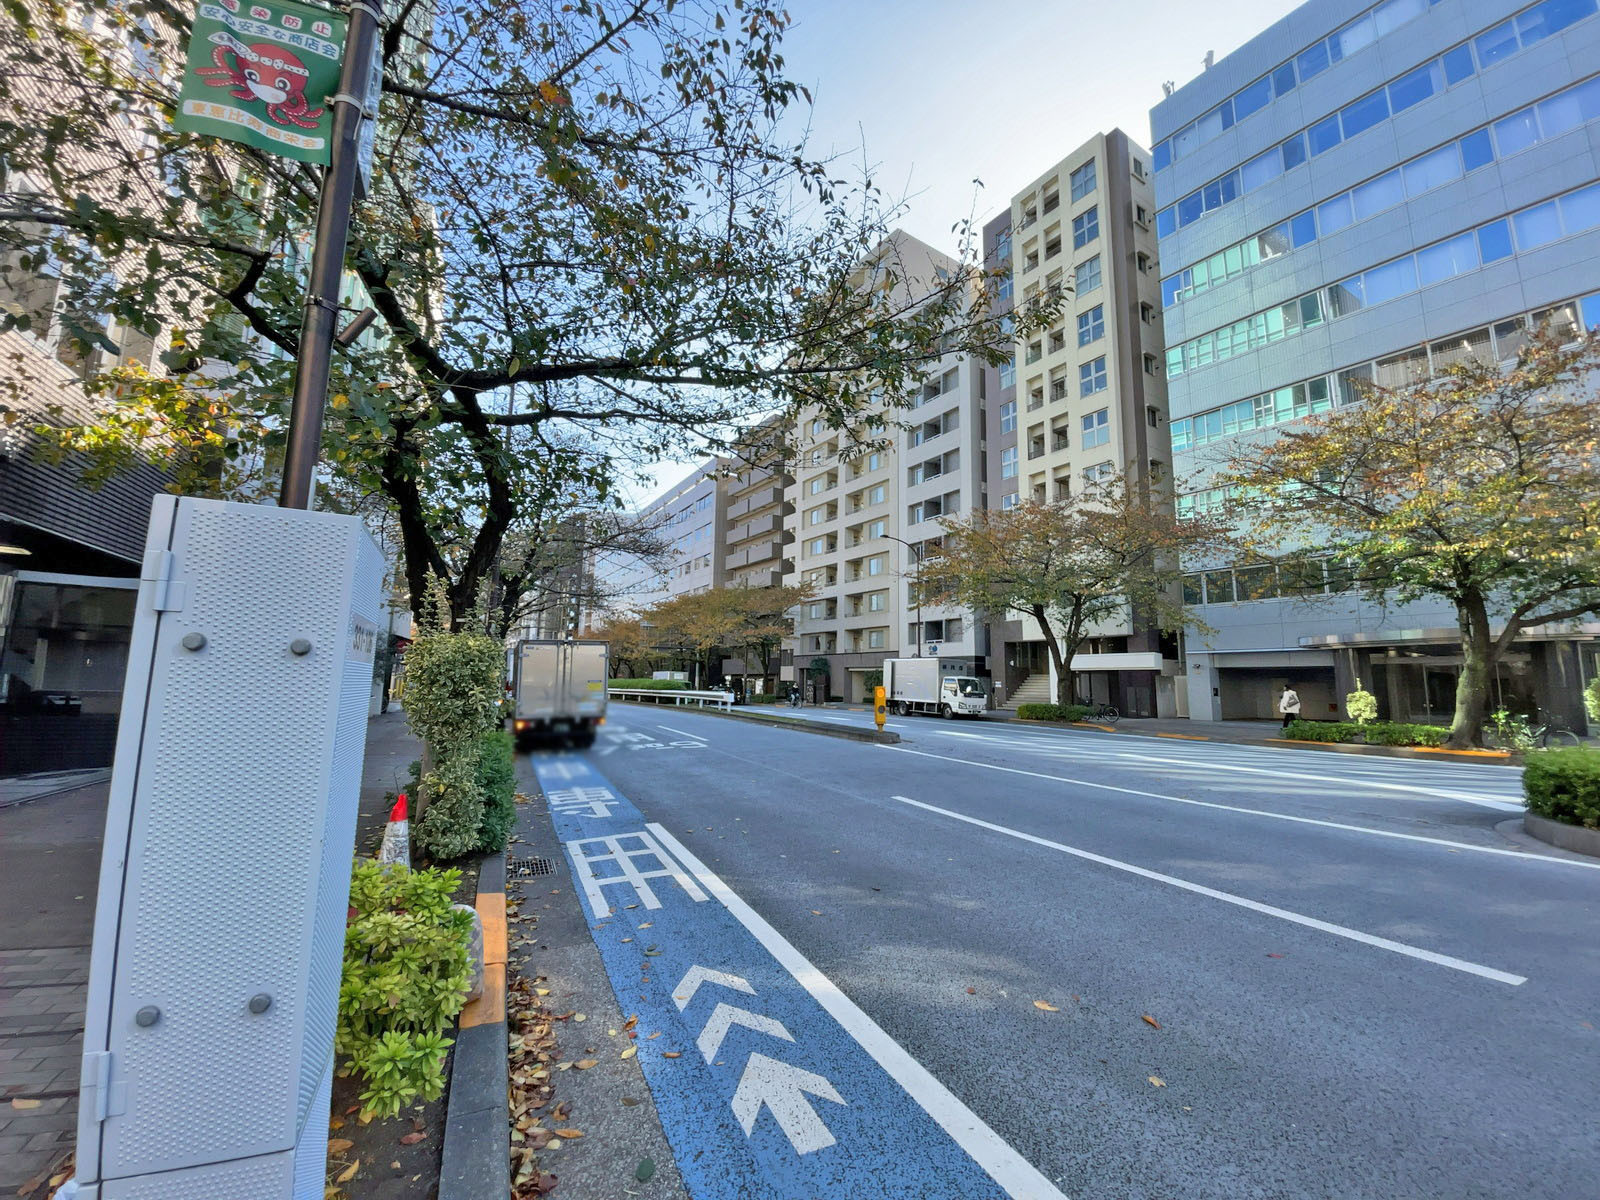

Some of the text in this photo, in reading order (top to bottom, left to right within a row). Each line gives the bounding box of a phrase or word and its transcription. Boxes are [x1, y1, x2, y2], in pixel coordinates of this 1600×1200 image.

[203, 6, 336, 58] 安心安全な商店会
